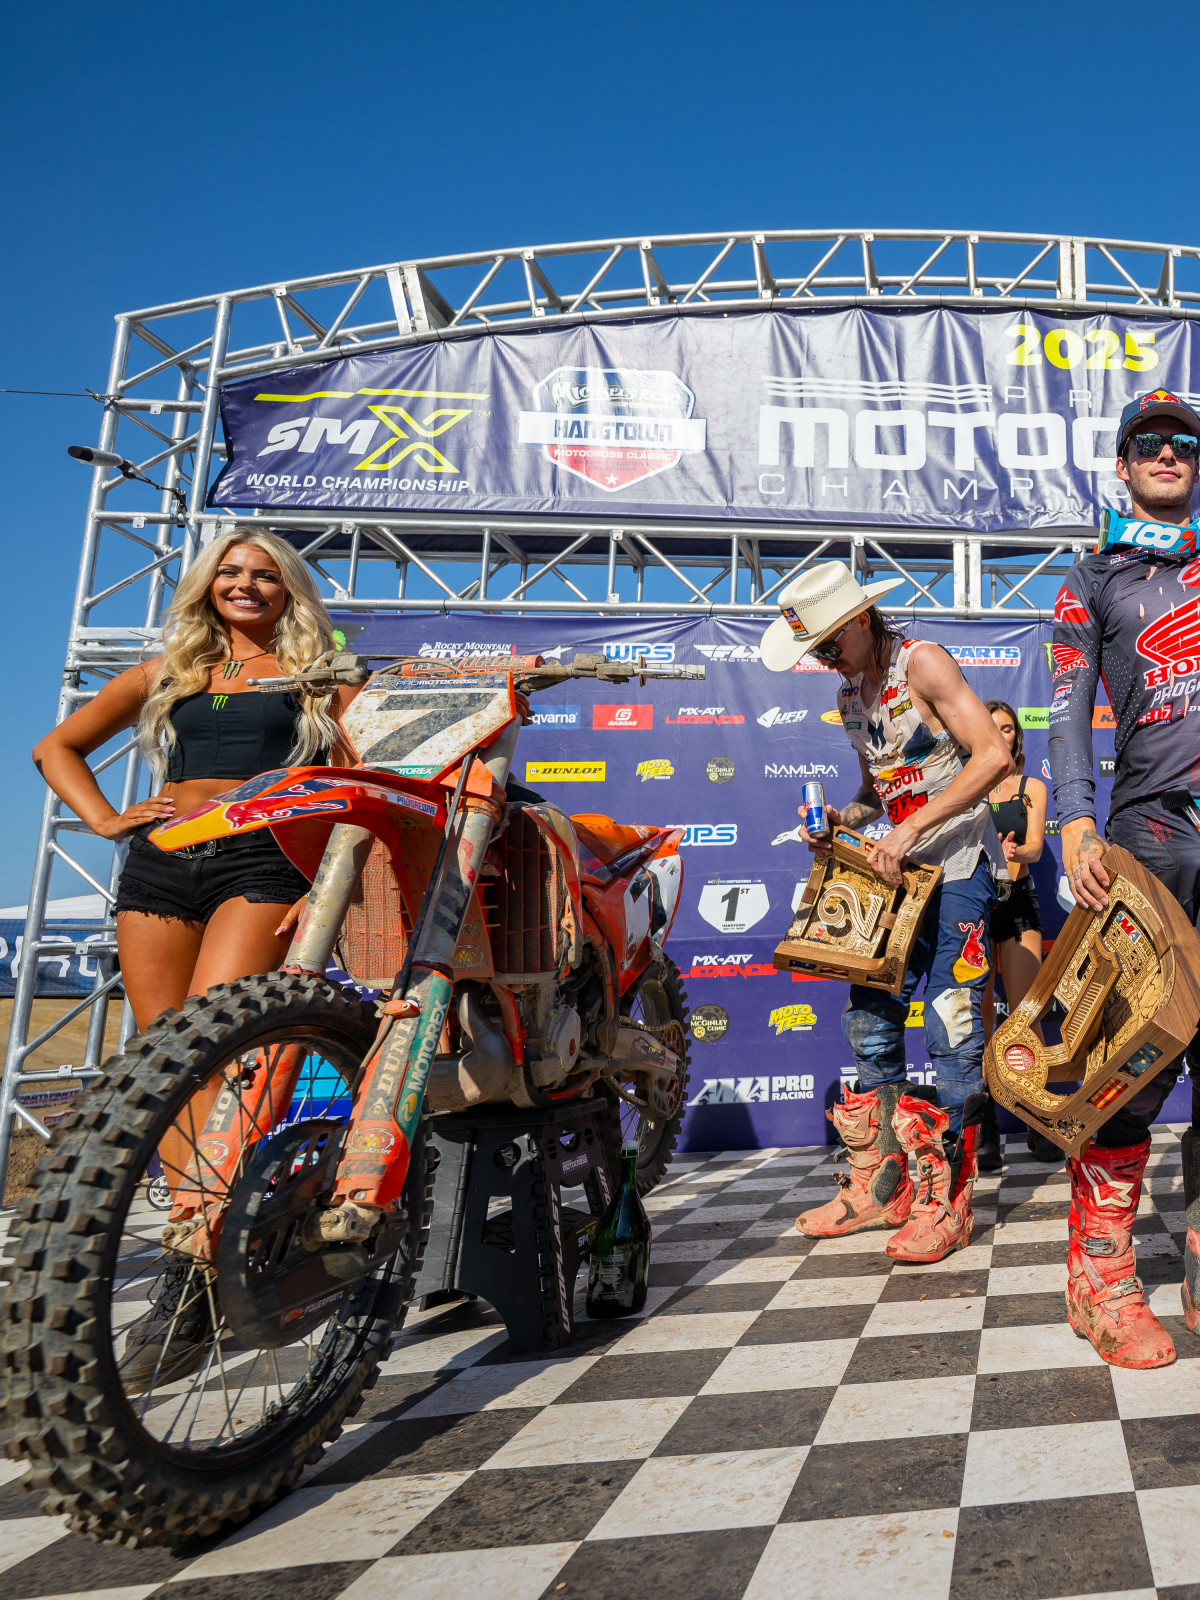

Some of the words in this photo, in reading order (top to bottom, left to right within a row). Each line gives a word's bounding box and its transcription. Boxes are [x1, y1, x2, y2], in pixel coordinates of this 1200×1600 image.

[1005, 324, 1159, 372] 2025
[553, 419, 673, 442] HANGTOWN
[257, 404, 461, 475] SMX
[553, 449, 624, 459] MOTOCROSS
[626, 451, 673, 461] CLASSIC
[246, 474, 318, 489] WORLD
[322, 476, 471, 493] CHAMPIONSHIP
[434, 641, 463, 651] ROCKY
[463, 641, 512, 651] MOUNTAIN
[604, 644, 674, 662] WPS
[956, 658, 1020, 667] NLIMITED
[530, 713, 577, 724] qvarna
[540, 765, 603, 774] DUNLOP
[637, 760, 671, 773] MOTO
[641, 765, 676, 782] TEES
[764, 762, 839, 775] NAMURA
[396, 795, 437, 817] PROGRESSIVE
[721, 886, 751, 922] 1ST
[691, 955, 719, 966] MX
[677, 963, 779, 979] LEGENDS
[769, 1004, 813, 1023] MOTO
[690, 1019, 728, 1027] MCGINLEY
[775, 1012, 818, 1035] TEES
[413, 999, 448, 1092] MOTOREX
[686, 1075, 770, 1107] AMA
[771, 1074, 815, 1092] PRO
[771, 1090, 815, 1101] RACING
